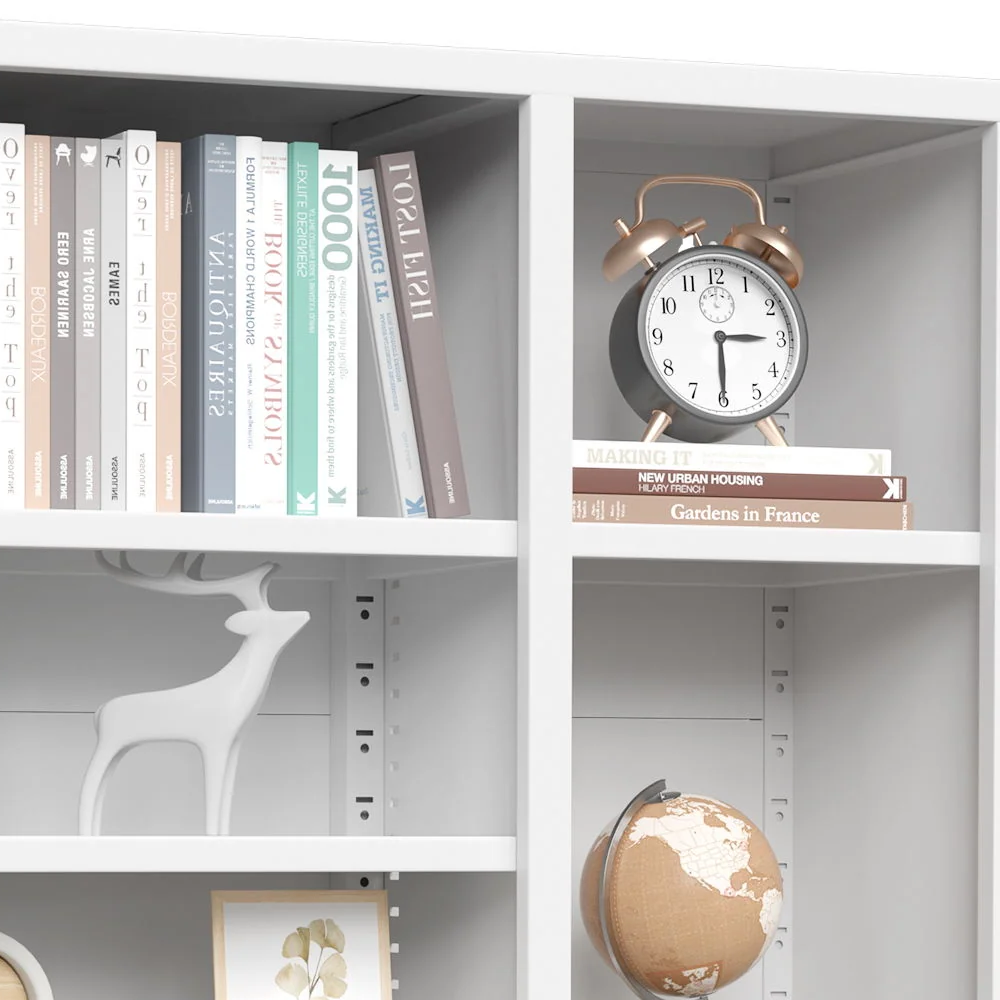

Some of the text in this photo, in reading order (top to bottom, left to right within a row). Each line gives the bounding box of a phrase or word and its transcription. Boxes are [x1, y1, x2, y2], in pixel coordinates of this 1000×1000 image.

[683, 276, 694, 291] 11
[709, 268, 724, 284] 12
[743, 276, 747, 292] 1
[662, 298, 676, 314] 10
[764, 298, 776, 316] 2
[652, 328, 662, 344] 9
[777, 331, 786, 347] 3
[664, 359, 673, 375] 8
[768, 362, 778, 377] 4
[689, 383, 697, 399] 7
[718, 390, 729, 408] 6
[753, 384, 761, 399] 5
[638, 472, 763, 487] NEW URBAN HOUSING
[638, 484, 705, 494] HILARY FRENCH
[670, 503, 820, 523] Gardens in France
